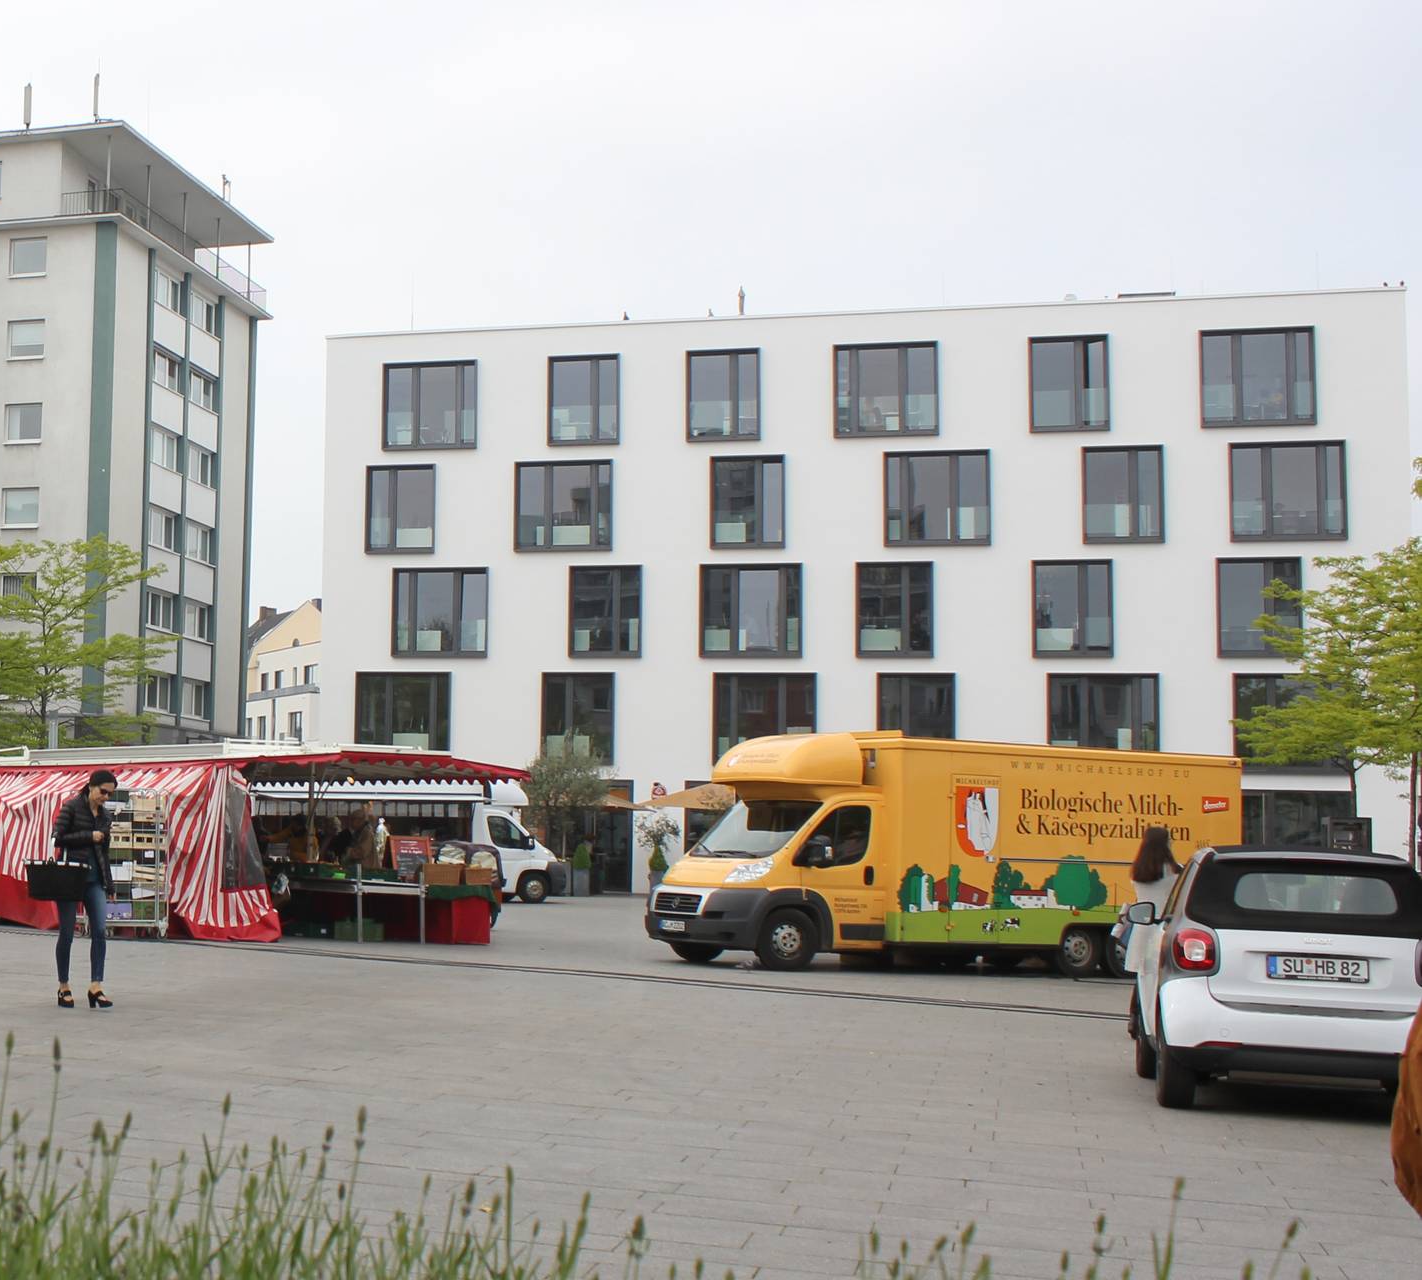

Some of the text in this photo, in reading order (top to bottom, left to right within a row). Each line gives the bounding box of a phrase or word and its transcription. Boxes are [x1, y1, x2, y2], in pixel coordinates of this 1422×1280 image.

[1056, 763, 1164, 777] MICHAELSHOF
[1174, 769, 1190, 778] EU
[1021, 788, 1184, 819] Biologische Milch-
[1016, 813, 1031, 835] &
[1037, 814, 1190, 845] Käsespezialien
[1282, 958, 1360, 977] SU HB 82
